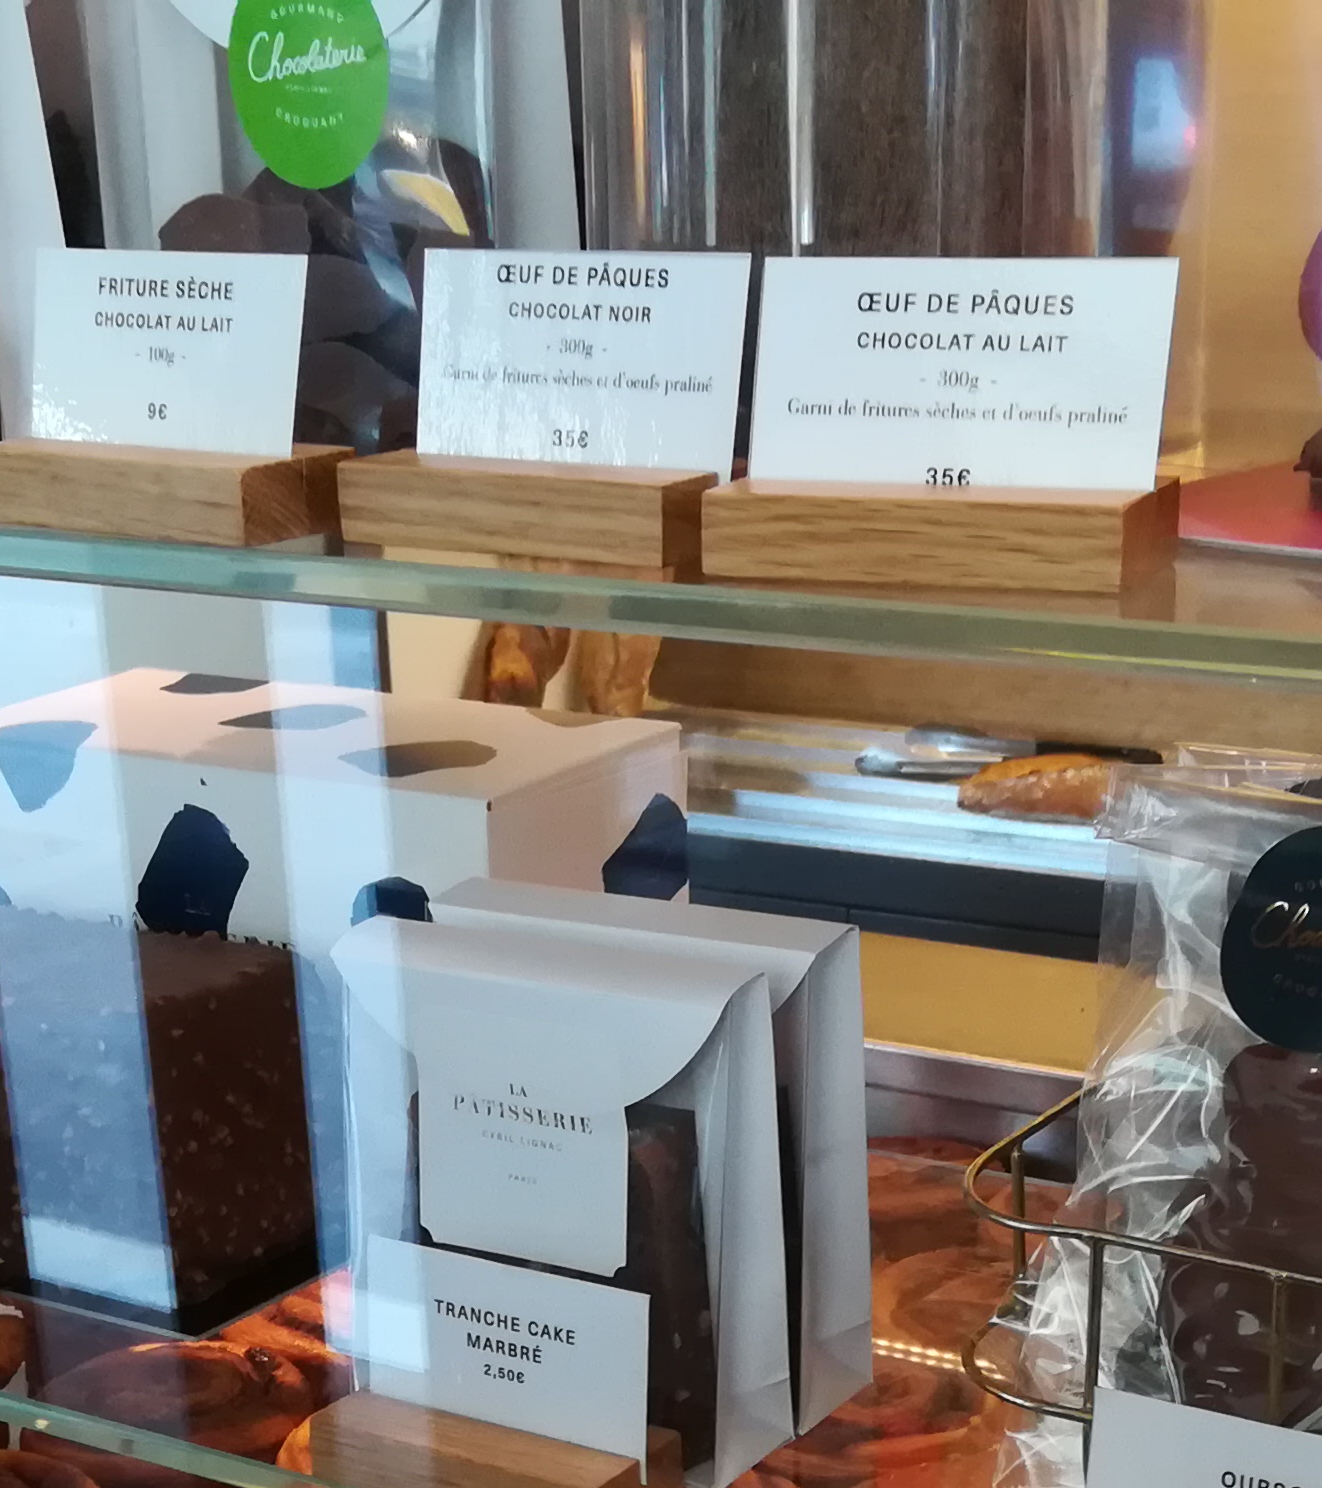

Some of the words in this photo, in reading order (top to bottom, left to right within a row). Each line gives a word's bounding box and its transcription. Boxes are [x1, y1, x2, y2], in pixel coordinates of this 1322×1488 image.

[248, 31, 367, 83] Chocolaterie
[275, 107, 343, 128] CROQUANT
[497, 263, 544, 284] ŒUF
[552, 266, 578, 285] DE
[587, 262, 670, 288] PÂQUES
[99, 277, 169, 297] FRITURE
[176, 276, 233, 300] SÈCHE
[509, 302, 602, 321] CHOCOLAT
[609, 306, 651, 322] NOIR
[857, 292, 917, 313] ŒUF
[928, 293, 960, 314] DE
[971, 289, 1075, 316] PÂQUES
[95, 312, 171, 330] CHOCOLAT
[177, 316, 196, 331] AU
[202, 317, 233, 332] LAIT
[857, 332, 975, 351] CHOCOLAT
[982, 335, 1011, 351] AU
[1020, 335, 1069, 353] LAIT
[665, 377, 712, 395] praliné
[148, 402, 168, 420] 9€
[787, 398, 832, 416] Garni
[838, 399, 857, 416] de
[863, 400, 920, 418] fritures
[982, 406, 996, 421] et
[1068, 405, 1128, 428] praliné
[552, 429, 589, 449] 35€
[925, 467, 971, 486] 35€
[509, 1083, 527, 1098] LA
[481, 1130, 513, 1143] CYRIL
[434, 1299, 520, 1333] TRANCHE
[528, 1322, 576, 1346] CAKE
[467, 1332, 542, 1364] MARBRÉ
[484, 1364, 525, 1384] 2,50€
